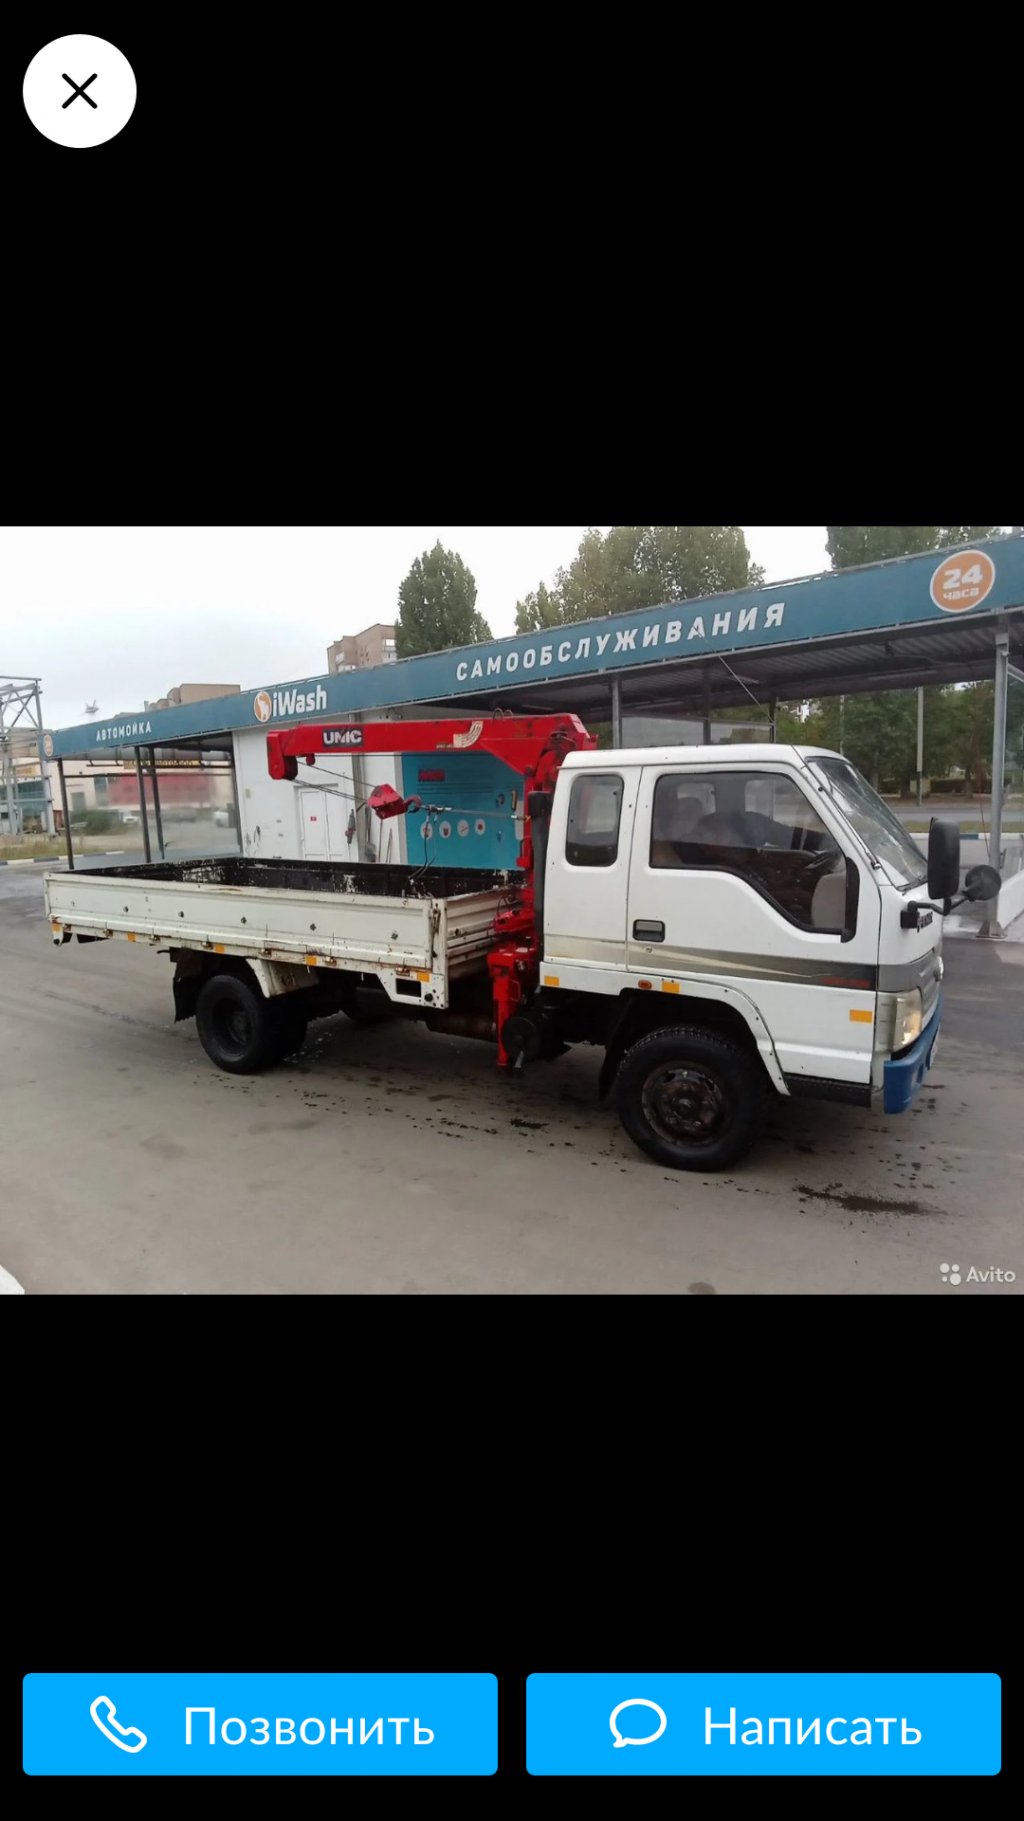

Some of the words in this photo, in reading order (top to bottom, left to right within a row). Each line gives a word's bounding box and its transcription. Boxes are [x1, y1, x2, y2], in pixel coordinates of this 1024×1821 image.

[943, 564, 983, 590] 24
[456, 602, 786, 681] САМООБСЛУЖИВАНИЯ
[272, 685, 328, 717] iWash
[96, 721, 153, 742] АВТОМОЙКА
